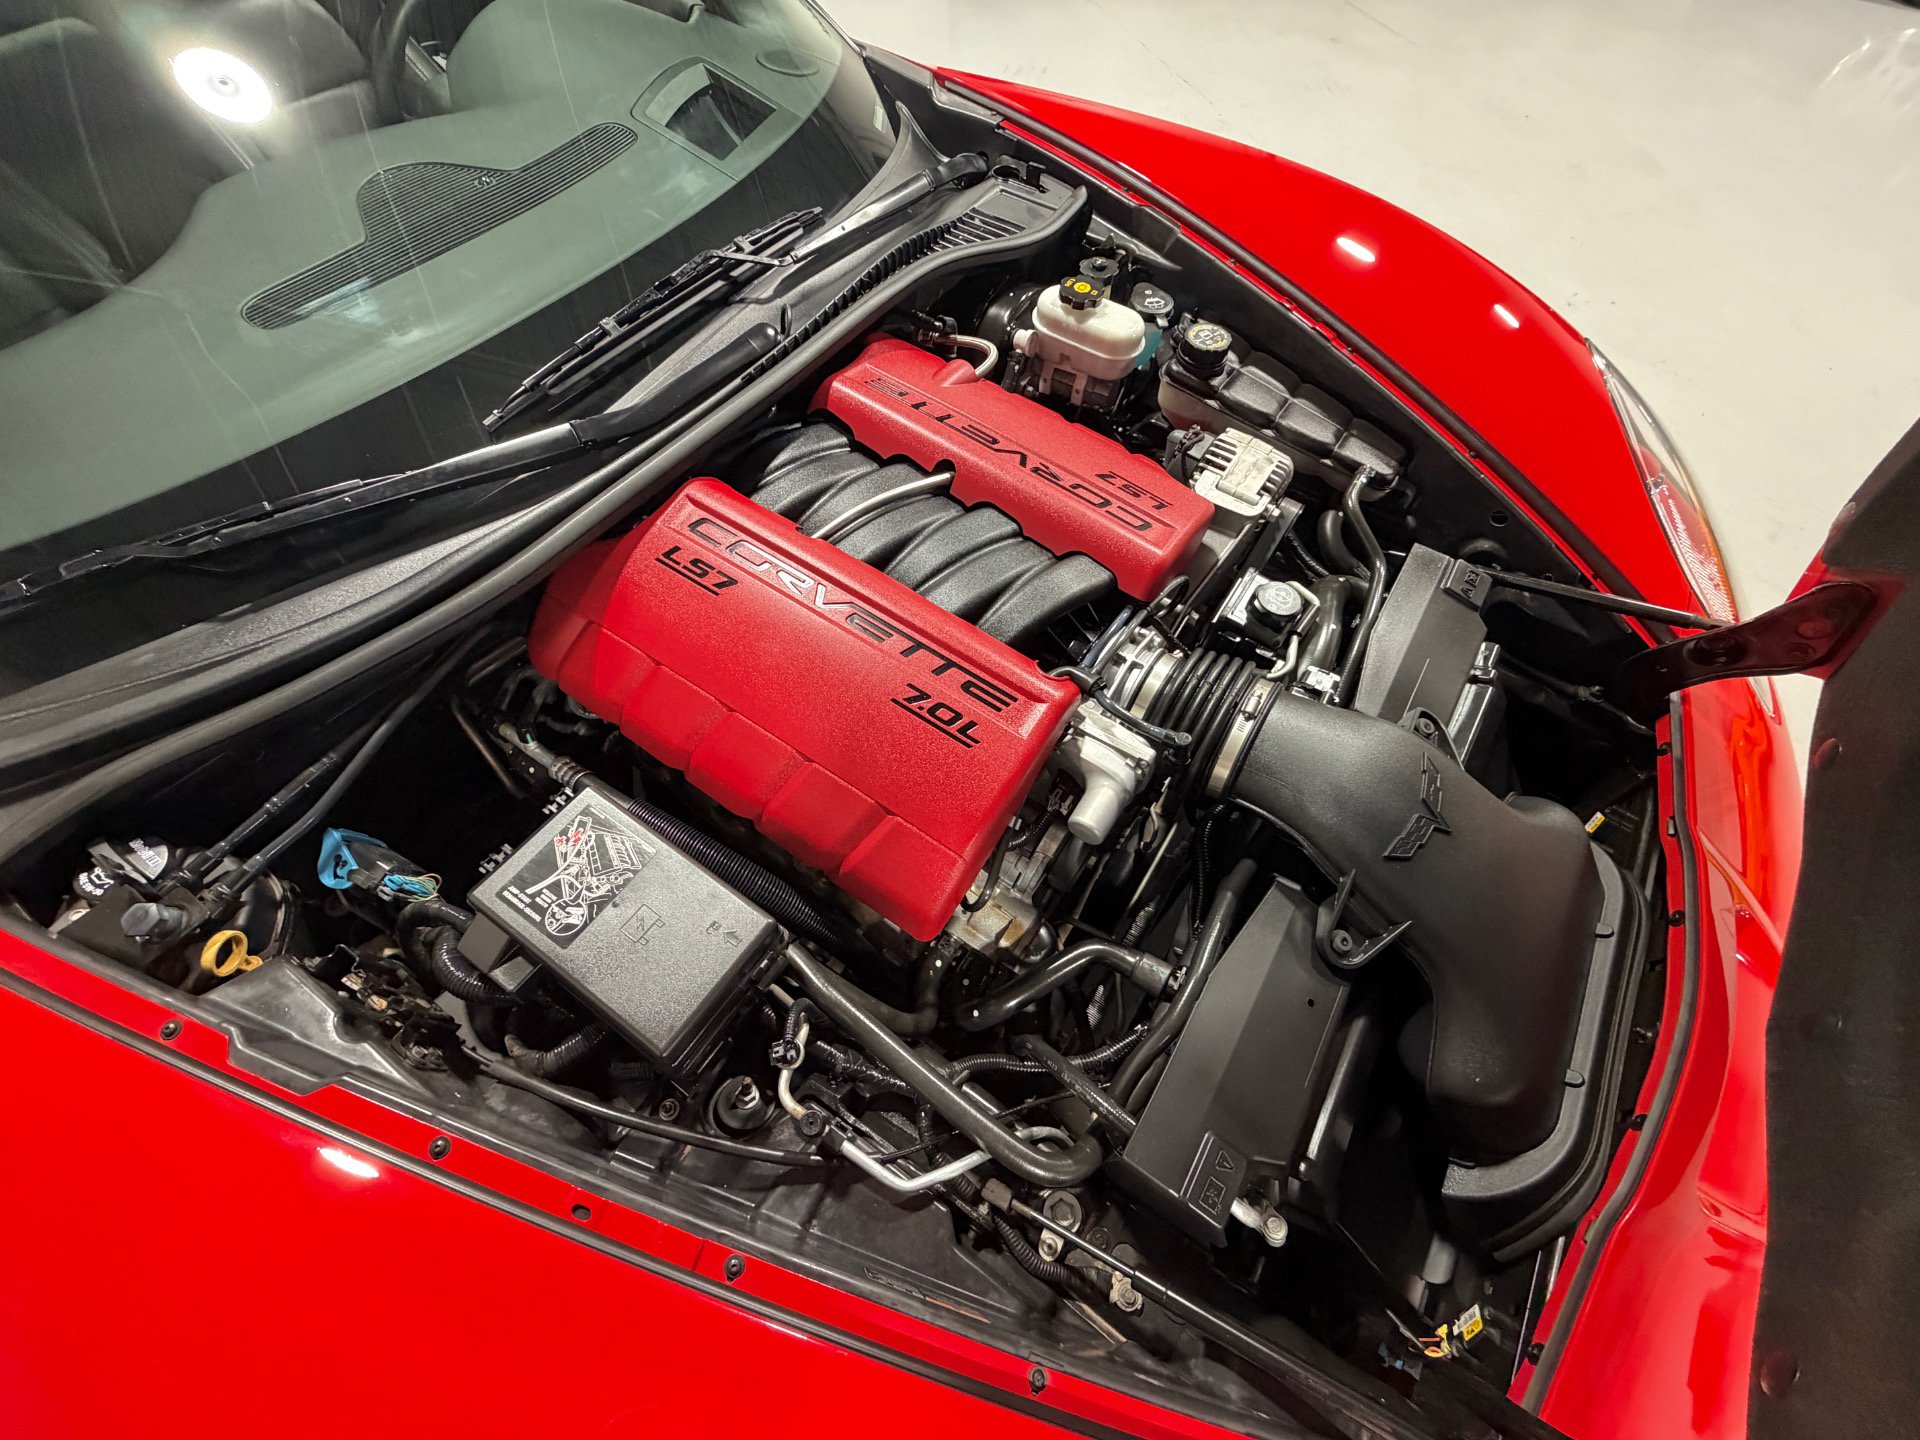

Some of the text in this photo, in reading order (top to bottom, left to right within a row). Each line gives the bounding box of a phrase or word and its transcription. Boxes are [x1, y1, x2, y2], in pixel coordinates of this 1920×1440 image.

[864, 377, 1153, 531] CORVETTE
[1095, 471, 1172, 510] LS7
[660, 545, 738, 592] LS7
[688, 517, 1019, 711] CORVETTE
[899, 683, 980, 745] 7.0L
